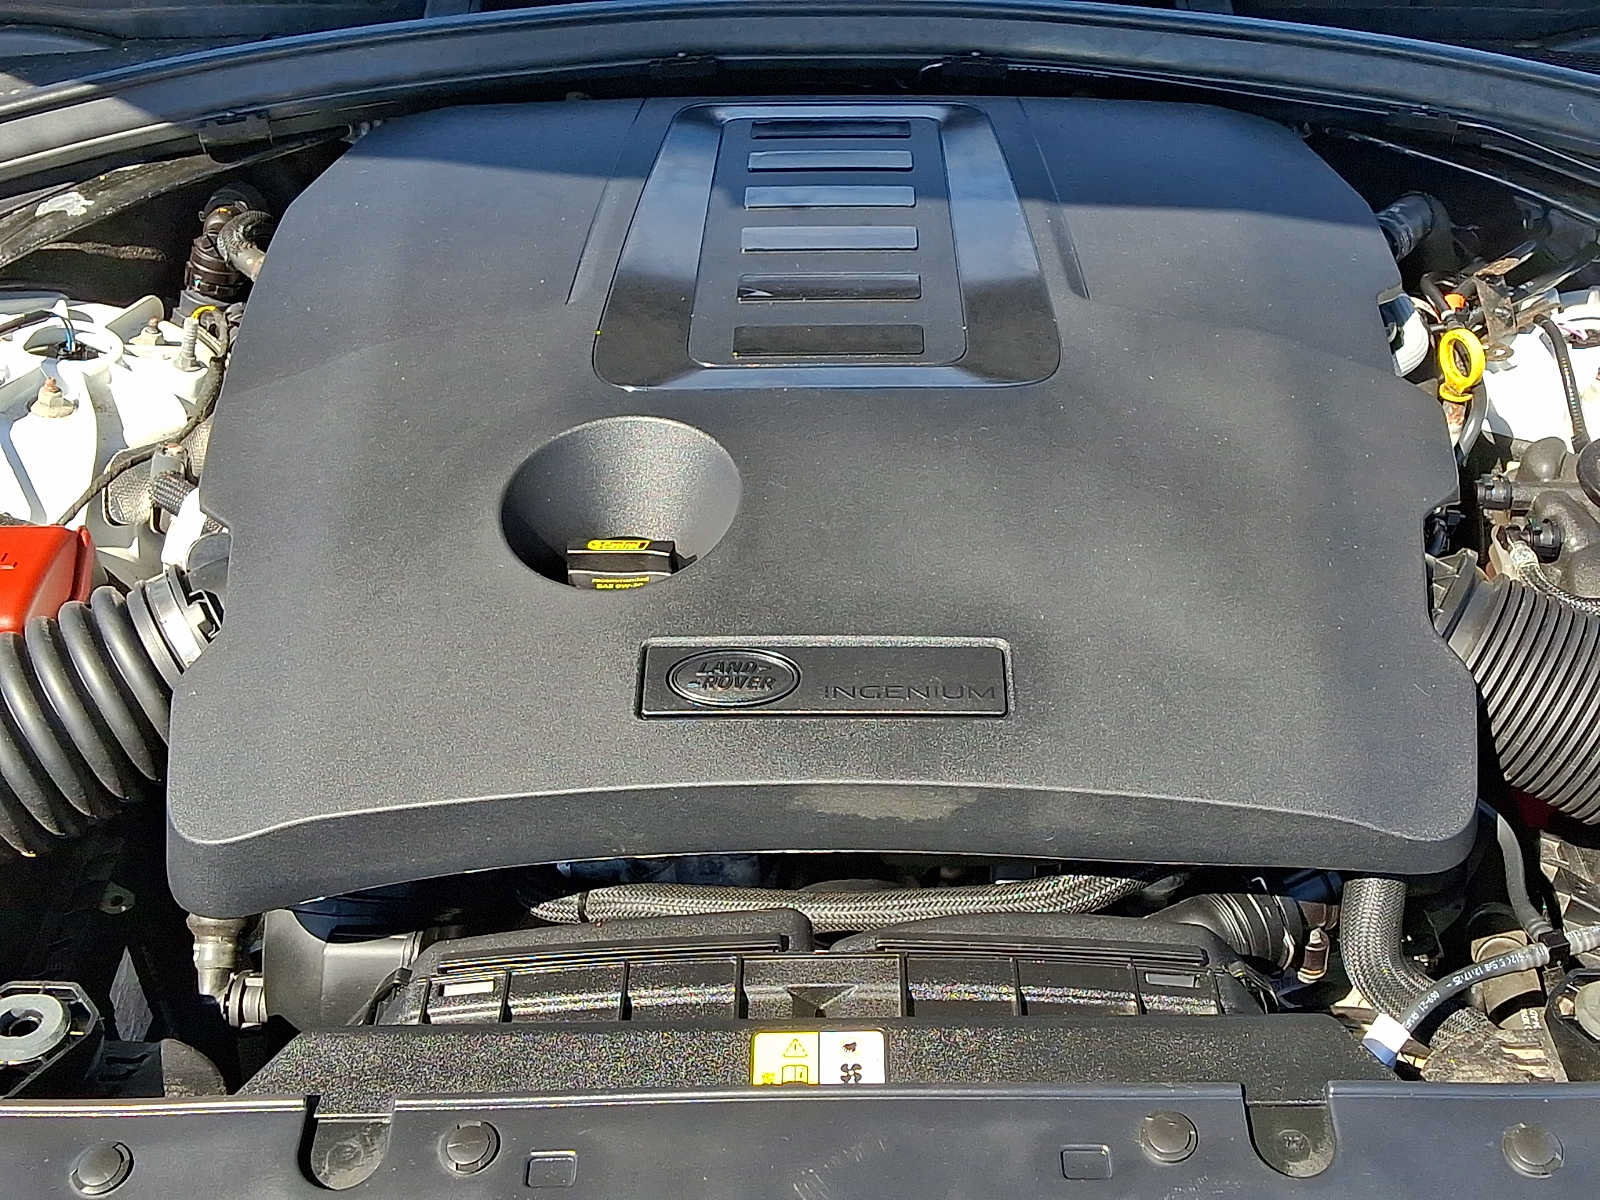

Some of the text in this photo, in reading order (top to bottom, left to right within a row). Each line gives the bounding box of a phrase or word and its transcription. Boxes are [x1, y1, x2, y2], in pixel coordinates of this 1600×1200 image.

[697, 660, 758, 675] LAND
[701, 675, 776, 691] ROVER
[824, 684, 997, 700] INGENIUM
